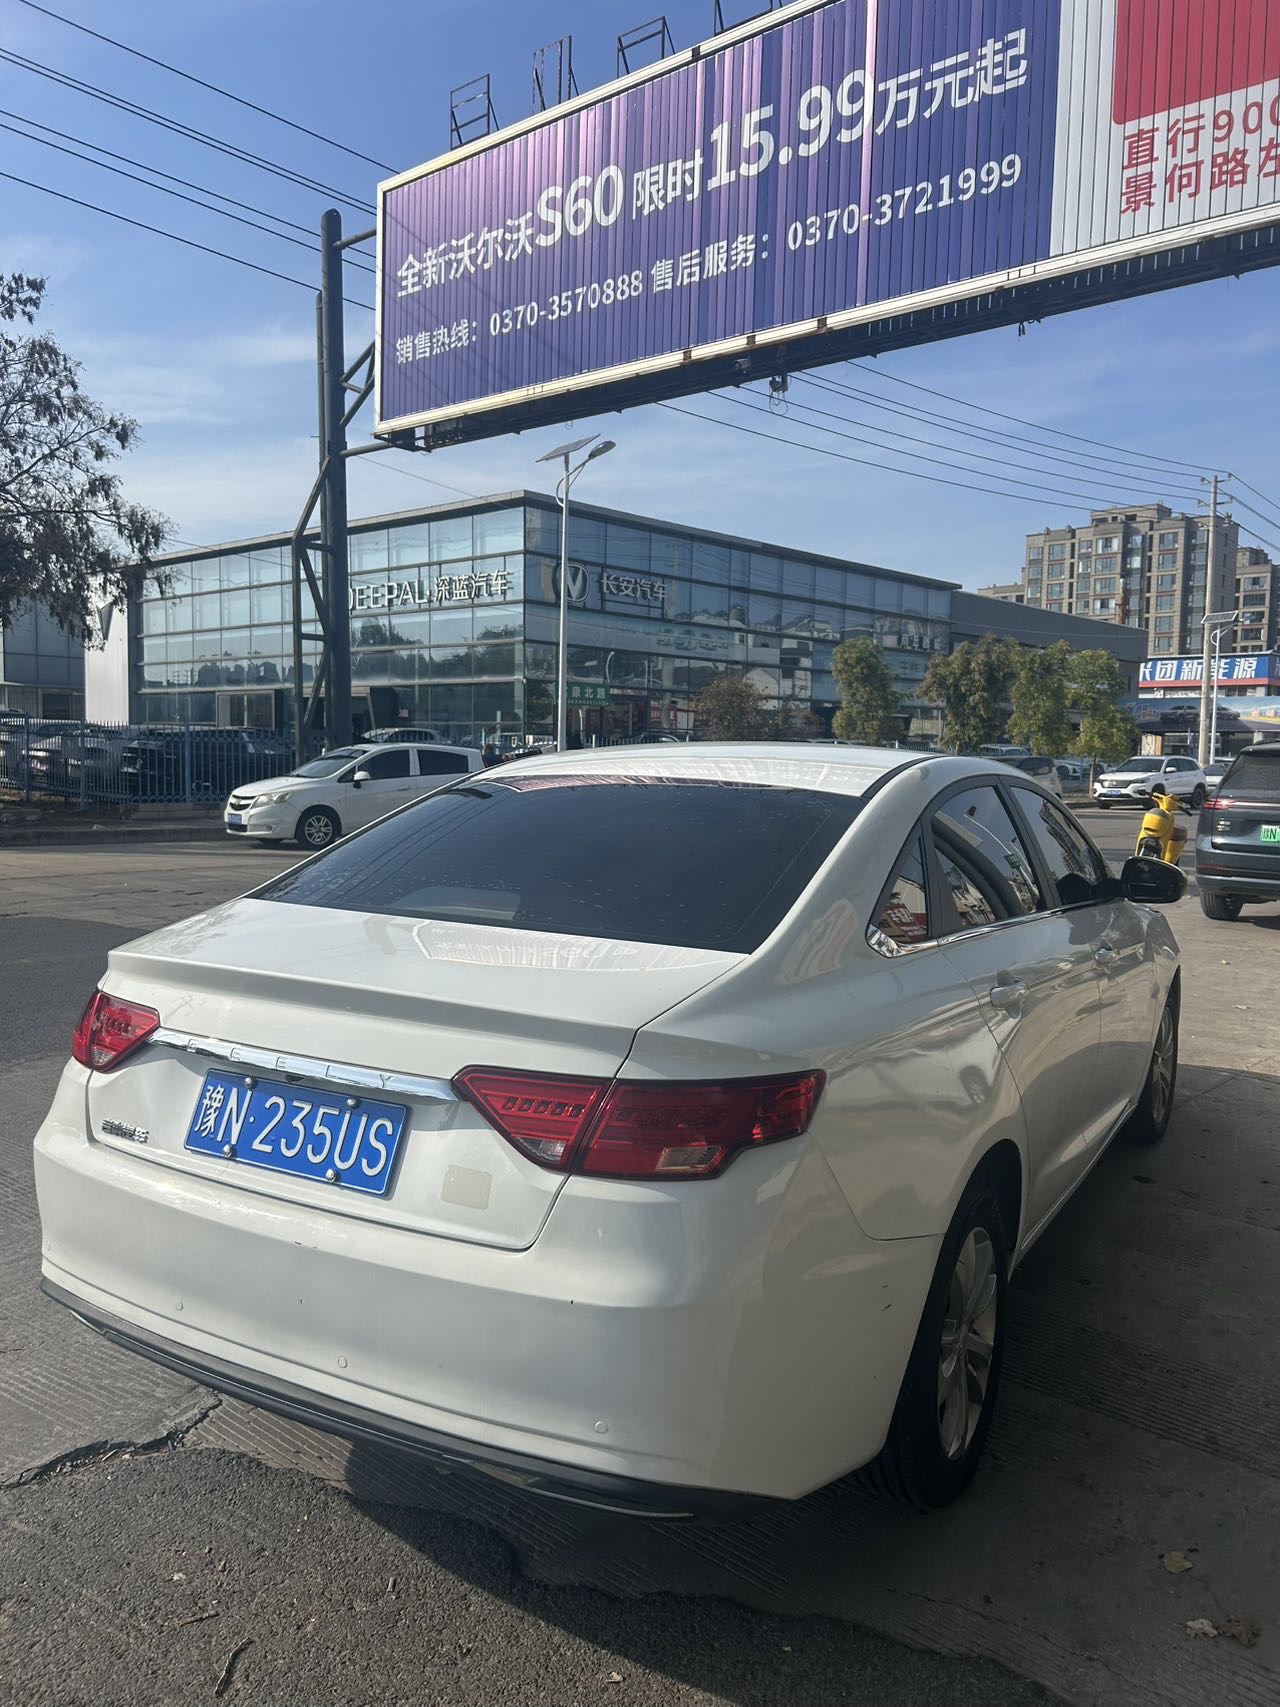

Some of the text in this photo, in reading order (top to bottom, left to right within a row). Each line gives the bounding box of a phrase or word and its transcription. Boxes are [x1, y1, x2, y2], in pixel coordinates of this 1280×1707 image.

[601, 573, 667, 601] 长安汽车
[186, 1038, 394, 1089] GEELY
[194, 1084, 394, 1177] 豫N·235US
